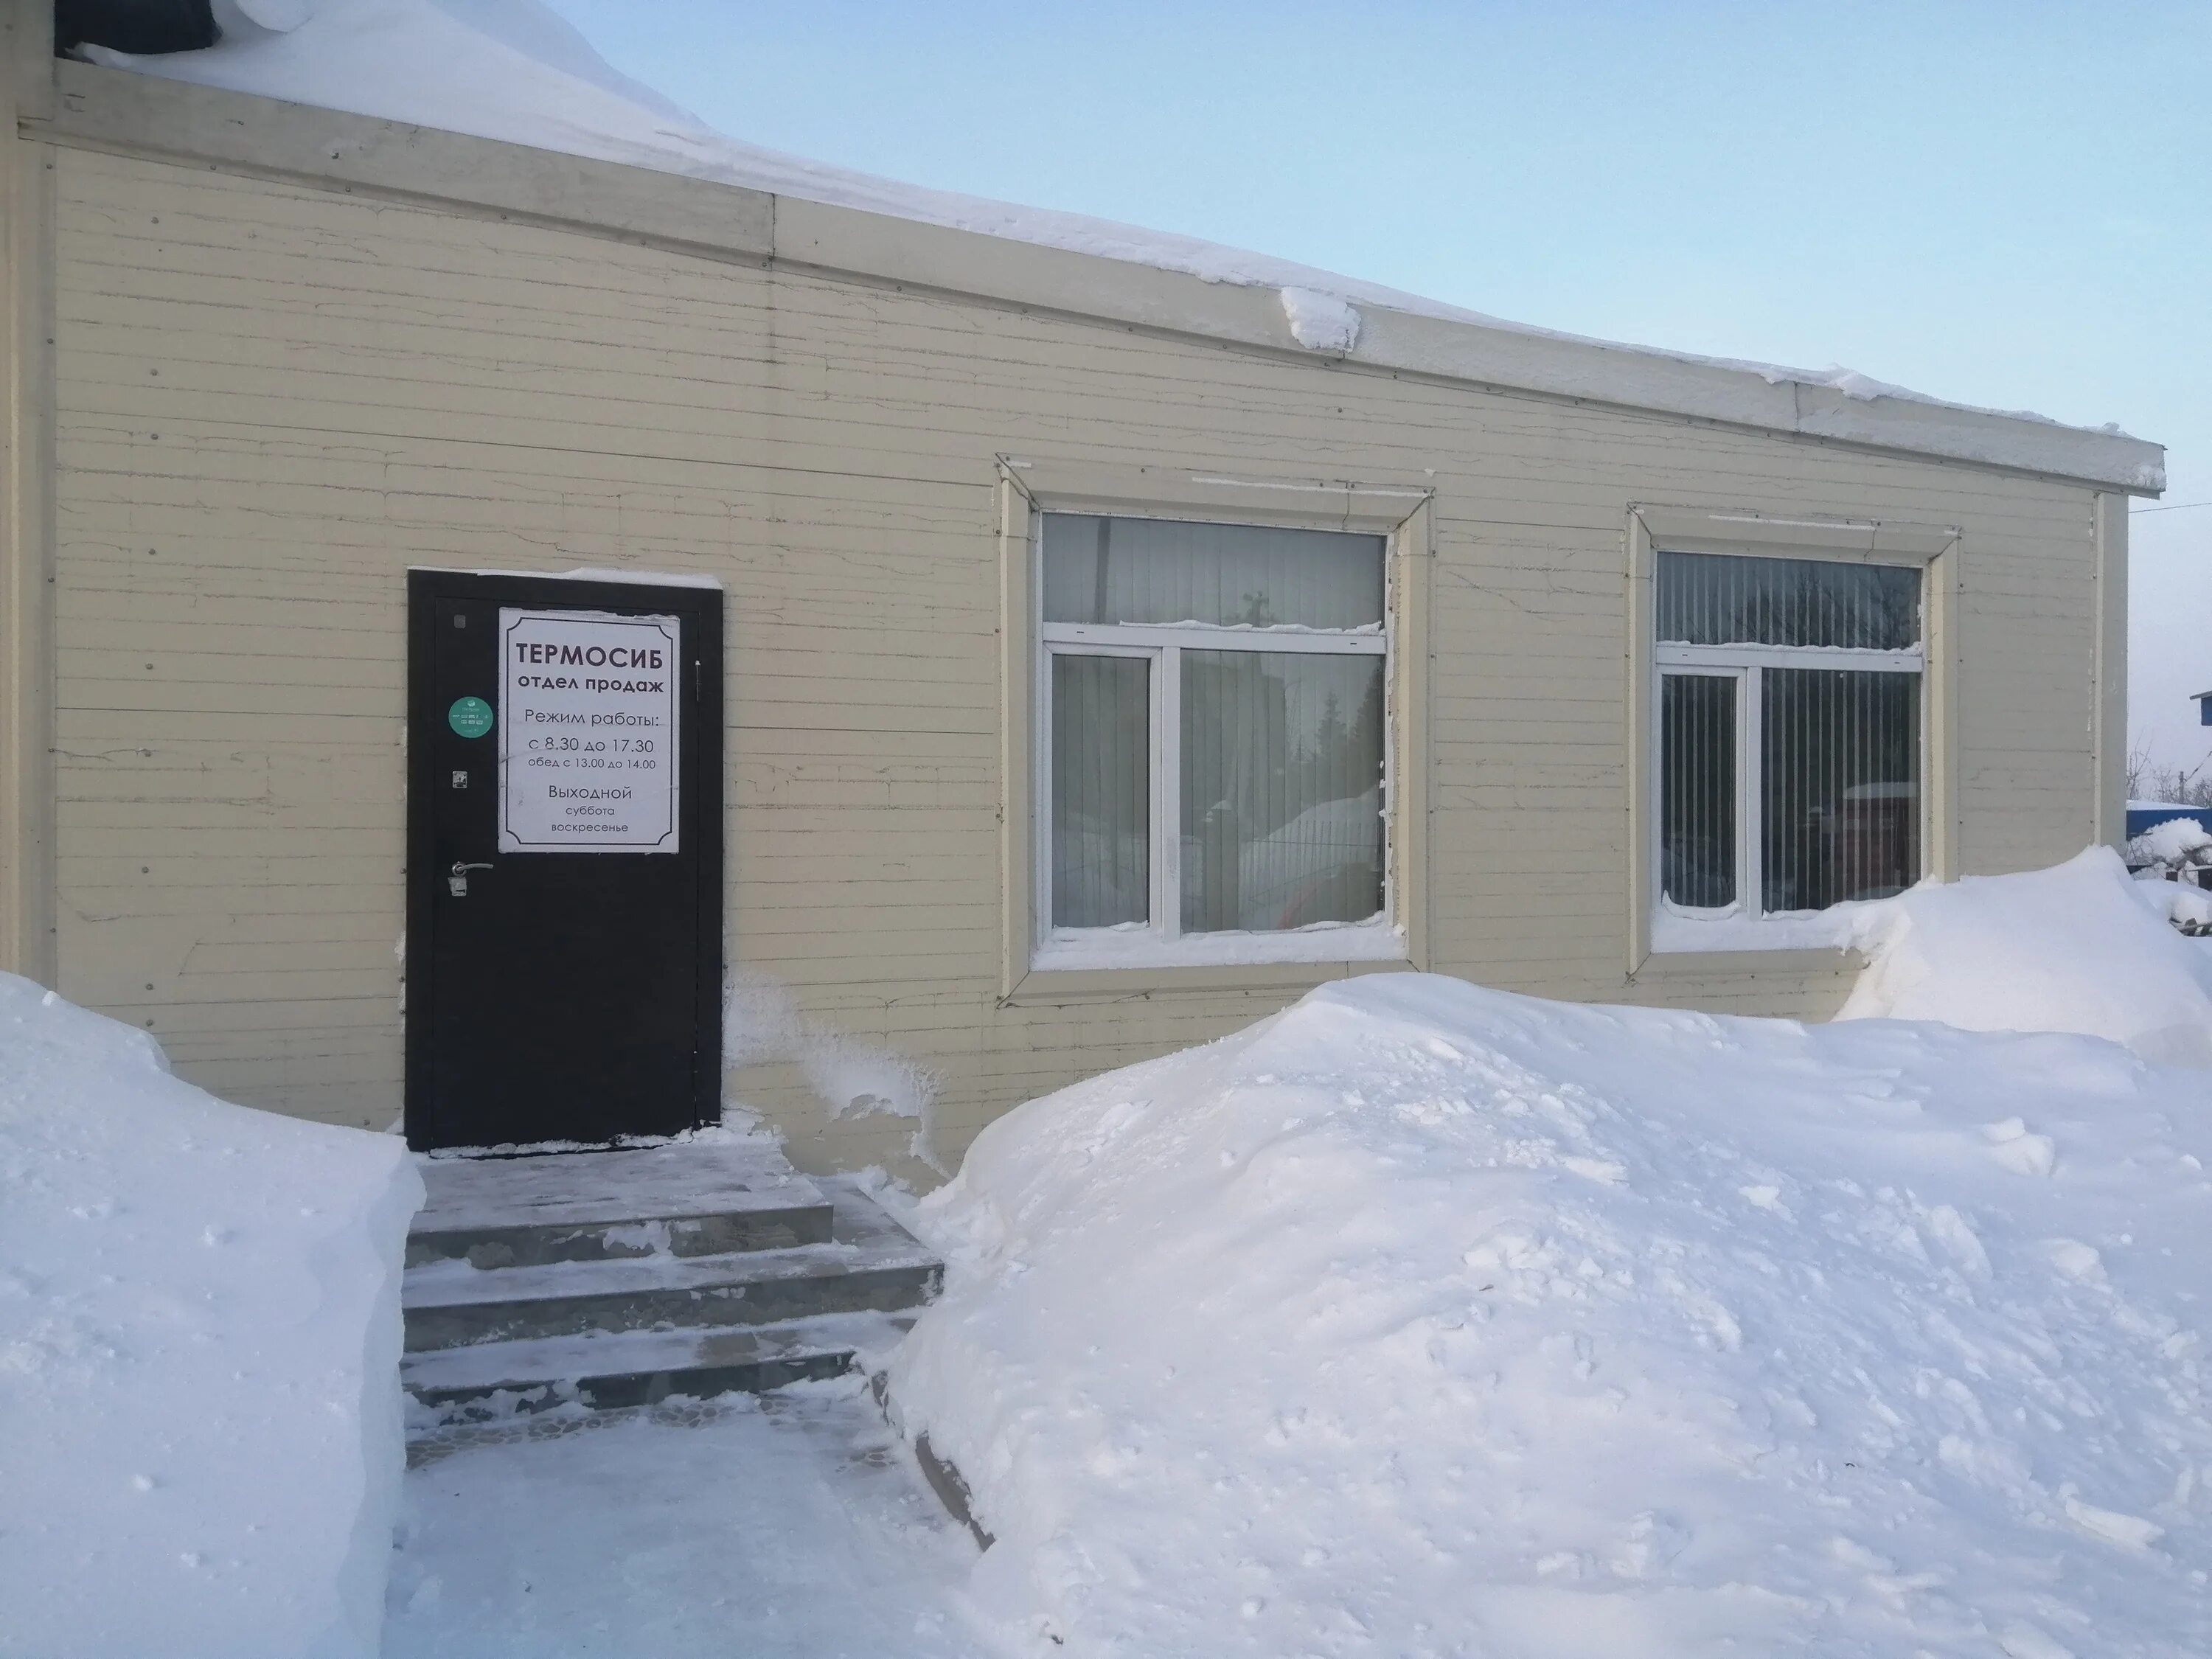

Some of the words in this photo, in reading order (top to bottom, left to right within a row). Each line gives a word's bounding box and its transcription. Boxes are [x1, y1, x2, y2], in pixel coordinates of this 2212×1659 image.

[516, 643, 663, 669] ТЕРМОСИБ
[518, 675, 578, 689] отдел
[586, 679, 664, 692] продаж
[525, 709, 585, 723] Режим
[591, 713, 659, 727] работы:
[529, 739, 539, 749] с
[545, 737, 579, 751] 8.30
[584, 740, 605, 752] до
[613, 740, 654, 753] 17.30
[529, 758, 560, 768] обед
[563, 759, 570, 768] с
[575, 759, 605, 768] 13.00
[608, 760, 622, 768] до
[627, 759, 656, 769] 14.00
[549, 785, 632, 799] Выходной
[566, 806, 615, 817] суббота
[552, 824, 628, 833] воскресенье
